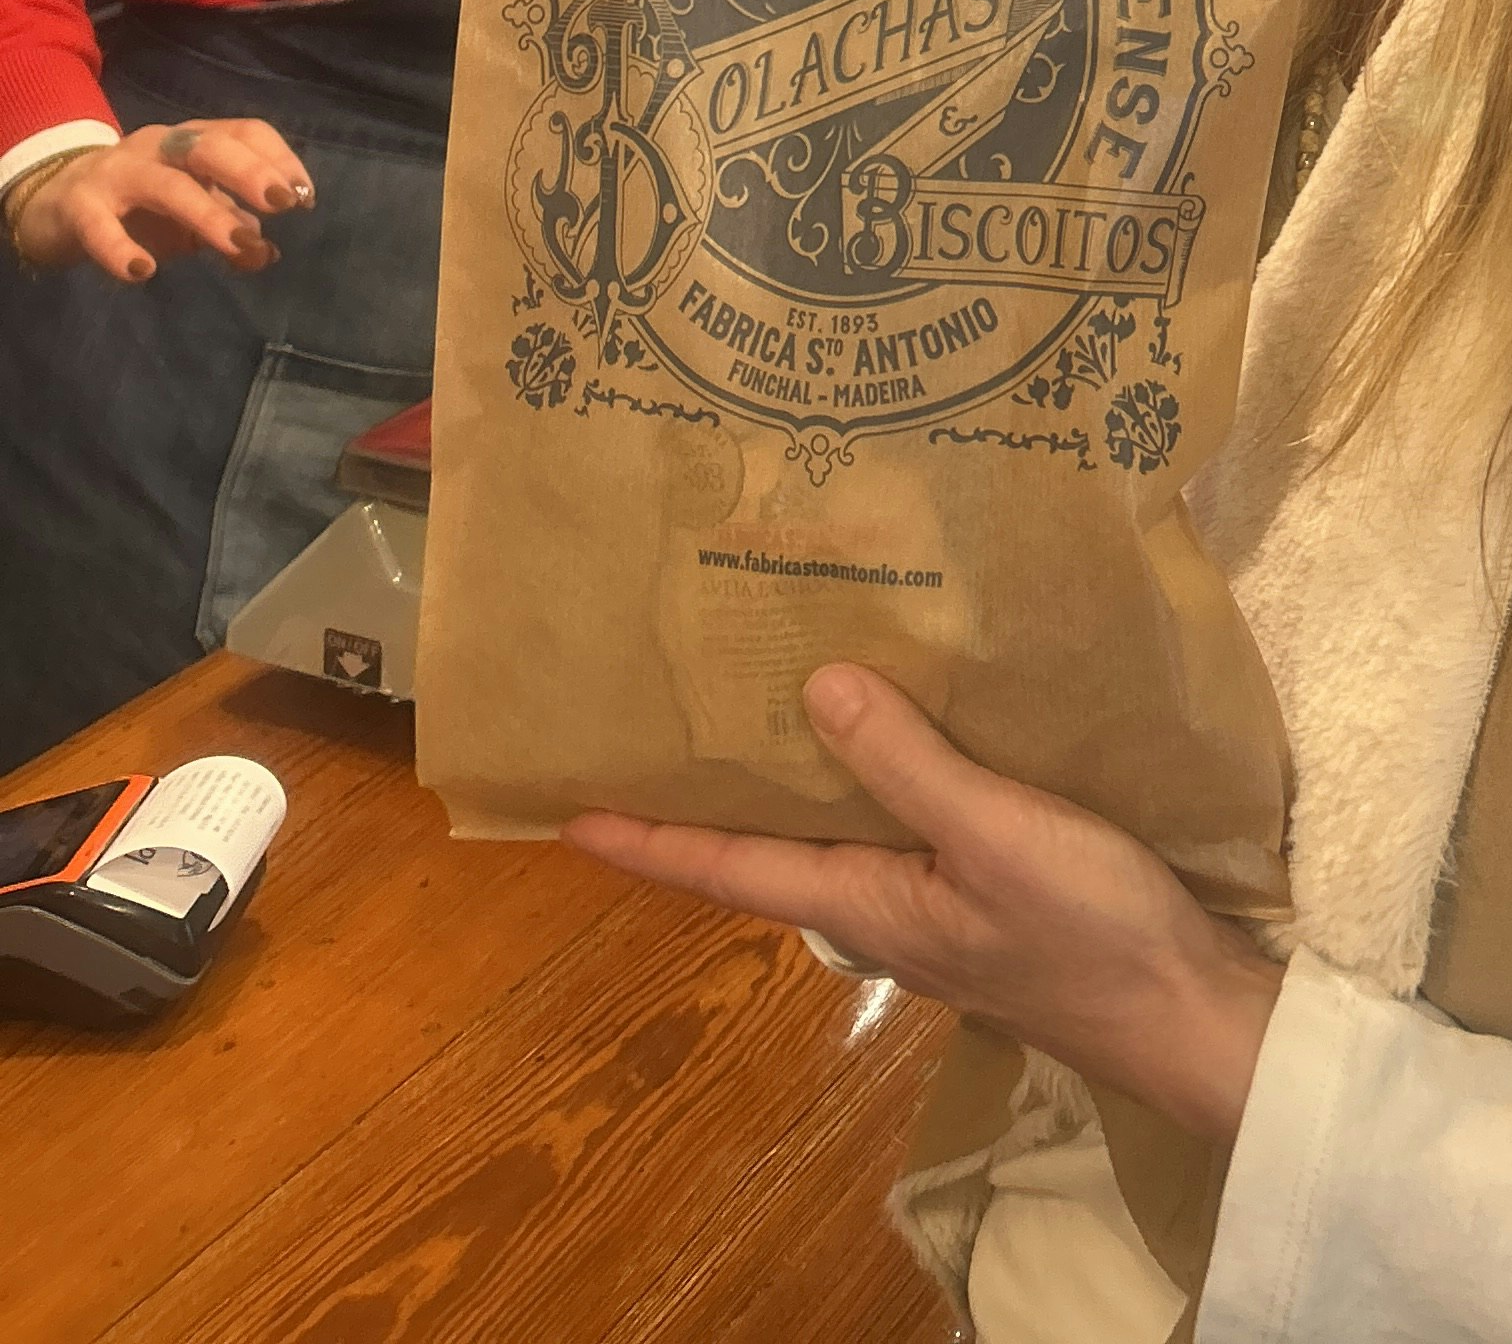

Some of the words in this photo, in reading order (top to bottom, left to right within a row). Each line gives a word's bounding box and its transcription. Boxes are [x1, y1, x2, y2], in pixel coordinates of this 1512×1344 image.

[938, 106, 978, 137] &
[786, 307, 822, 333] EST.
[831, 312, 878, 334] 1893
[852, 297, 999, 376] ANTONIO
[727, 358, 812, 405] FUNCHAL
[832, 374, 926, 409] MADEIRA
[698, 548, 943, 588] www.fabricastoantonio.com
